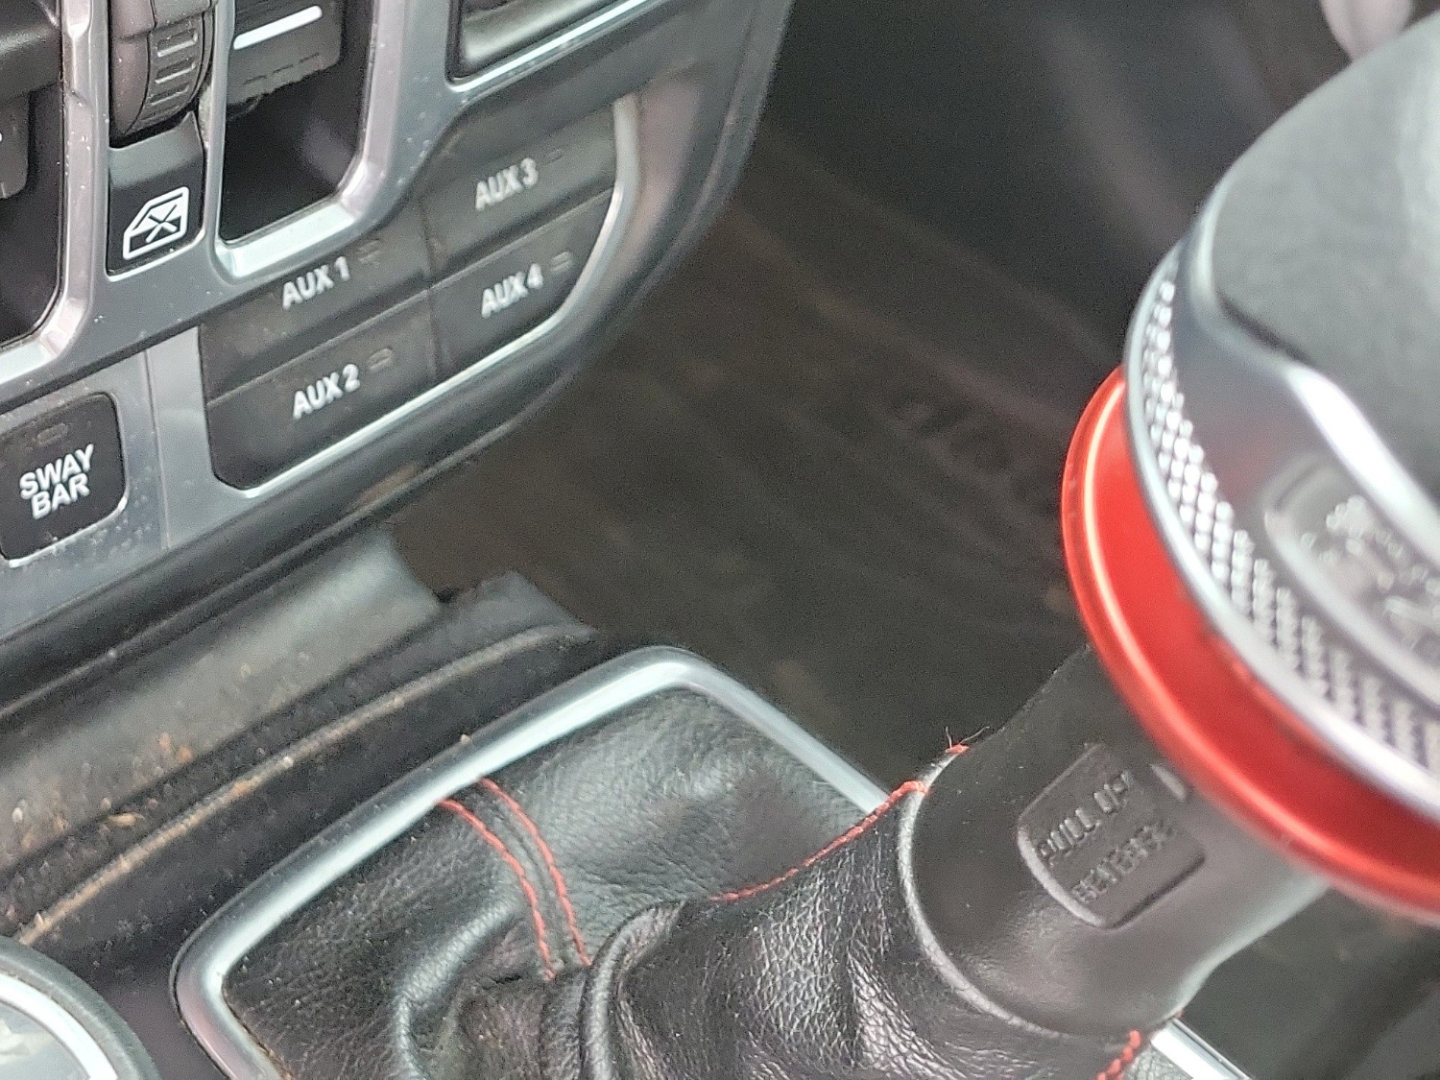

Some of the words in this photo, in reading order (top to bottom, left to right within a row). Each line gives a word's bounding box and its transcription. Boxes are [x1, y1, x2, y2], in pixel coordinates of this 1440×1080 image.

[474, 165, 523, 210] AUX
[520, 157, 539, 189] 3
[282, 265, 334, 311] AUX
[333, 256, 351, 282] 1
[480, 272, 528, 319] AUX
[527, 263, 544, 290] 4
[293, 372, 343, 419] AUX
[341, 364, 360, 392] 2
[19, 443, 94, 500] SWAY
[31, 473, 90, 520] BAR
